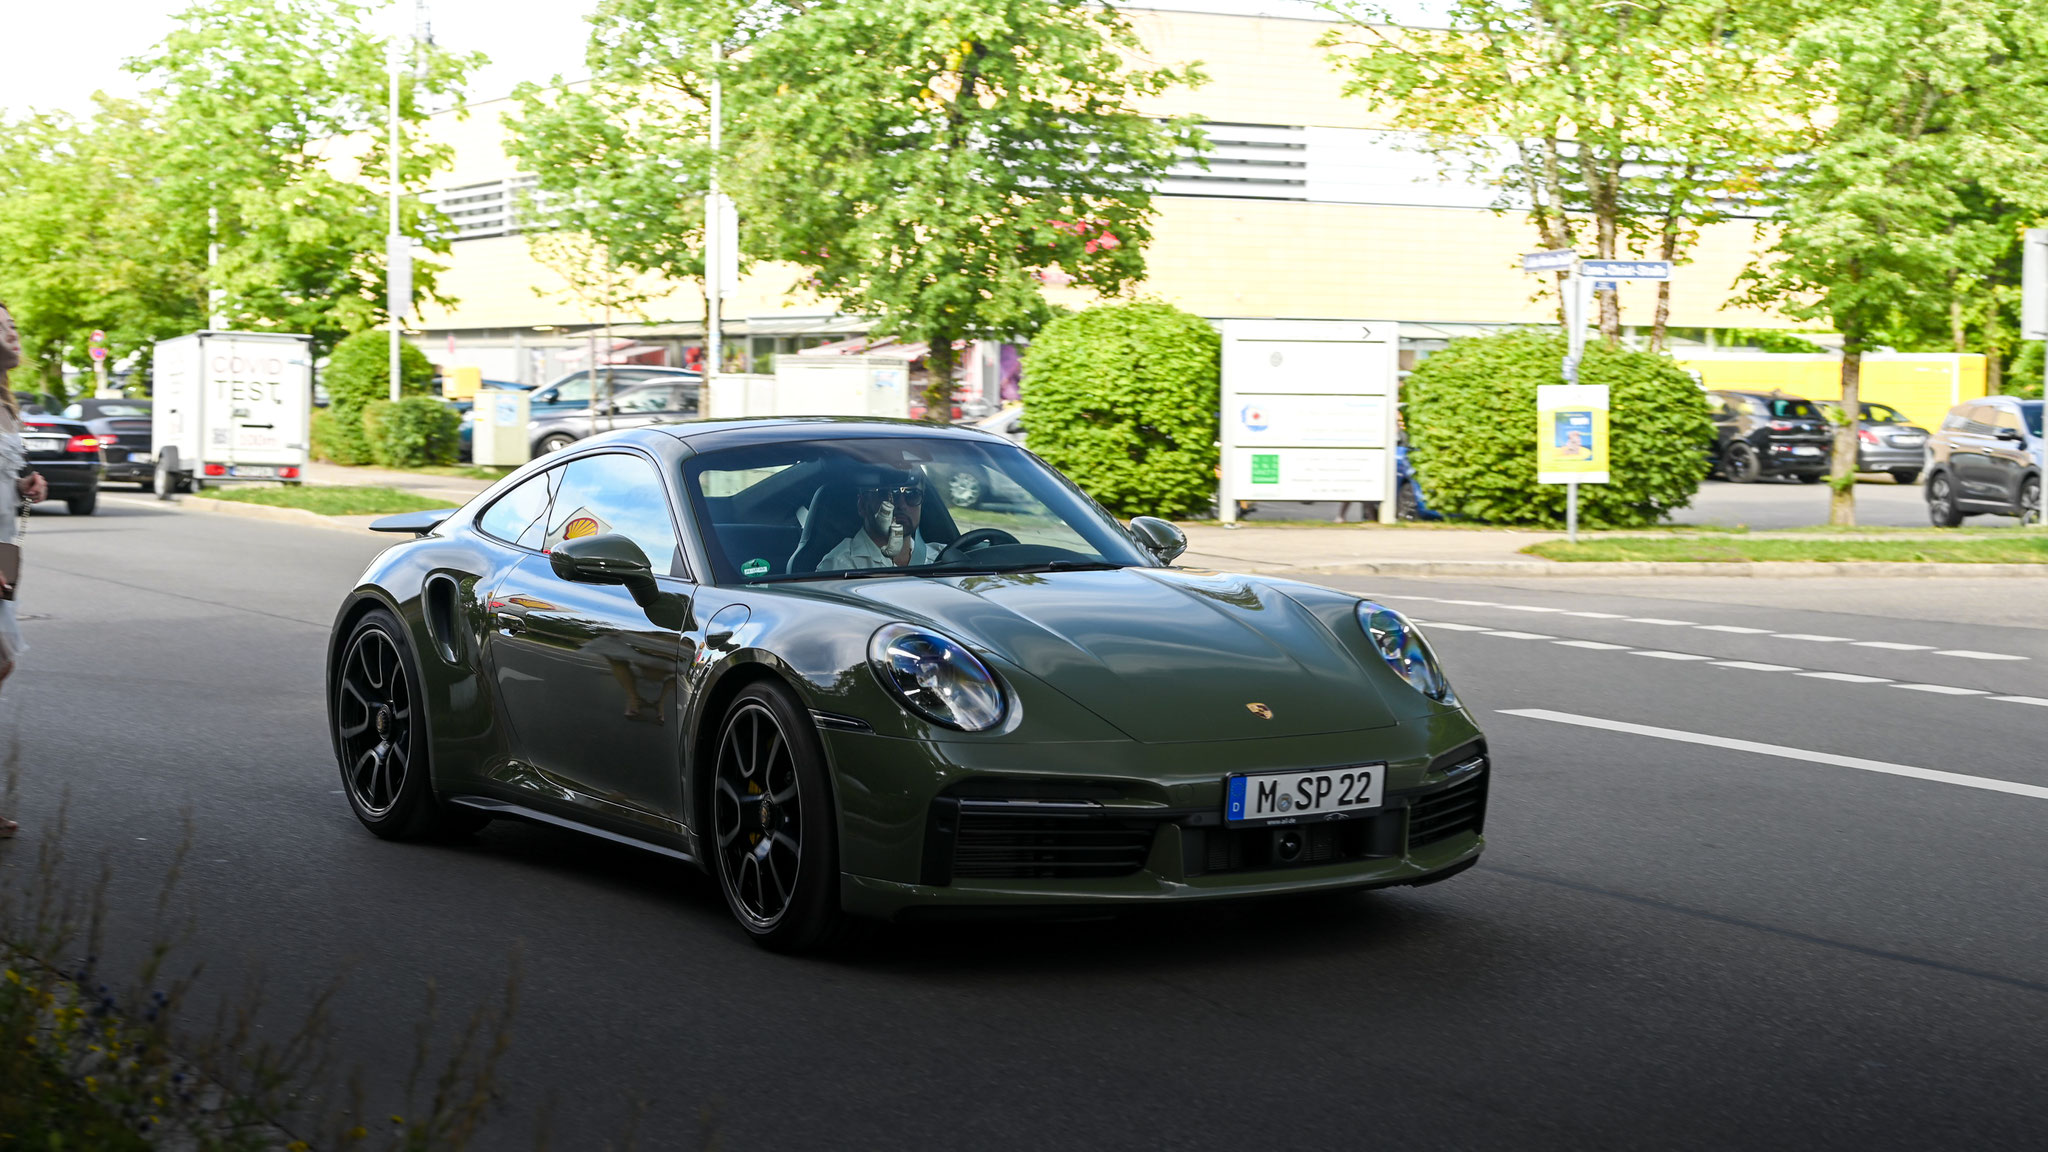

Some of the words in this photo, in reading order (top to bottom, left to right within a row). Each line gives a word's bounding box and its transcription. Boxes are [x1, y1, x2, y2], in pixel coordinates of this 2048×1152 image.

[211, 356, 282, 375] COVID
[213, 380, 280, 401] TEST
[1257, 780, 1278, 813] M
[1295, 775, 1332, 810] SP
[1338, 771, 1372, 806] 22
[1232, 802, 1241, 812] D
